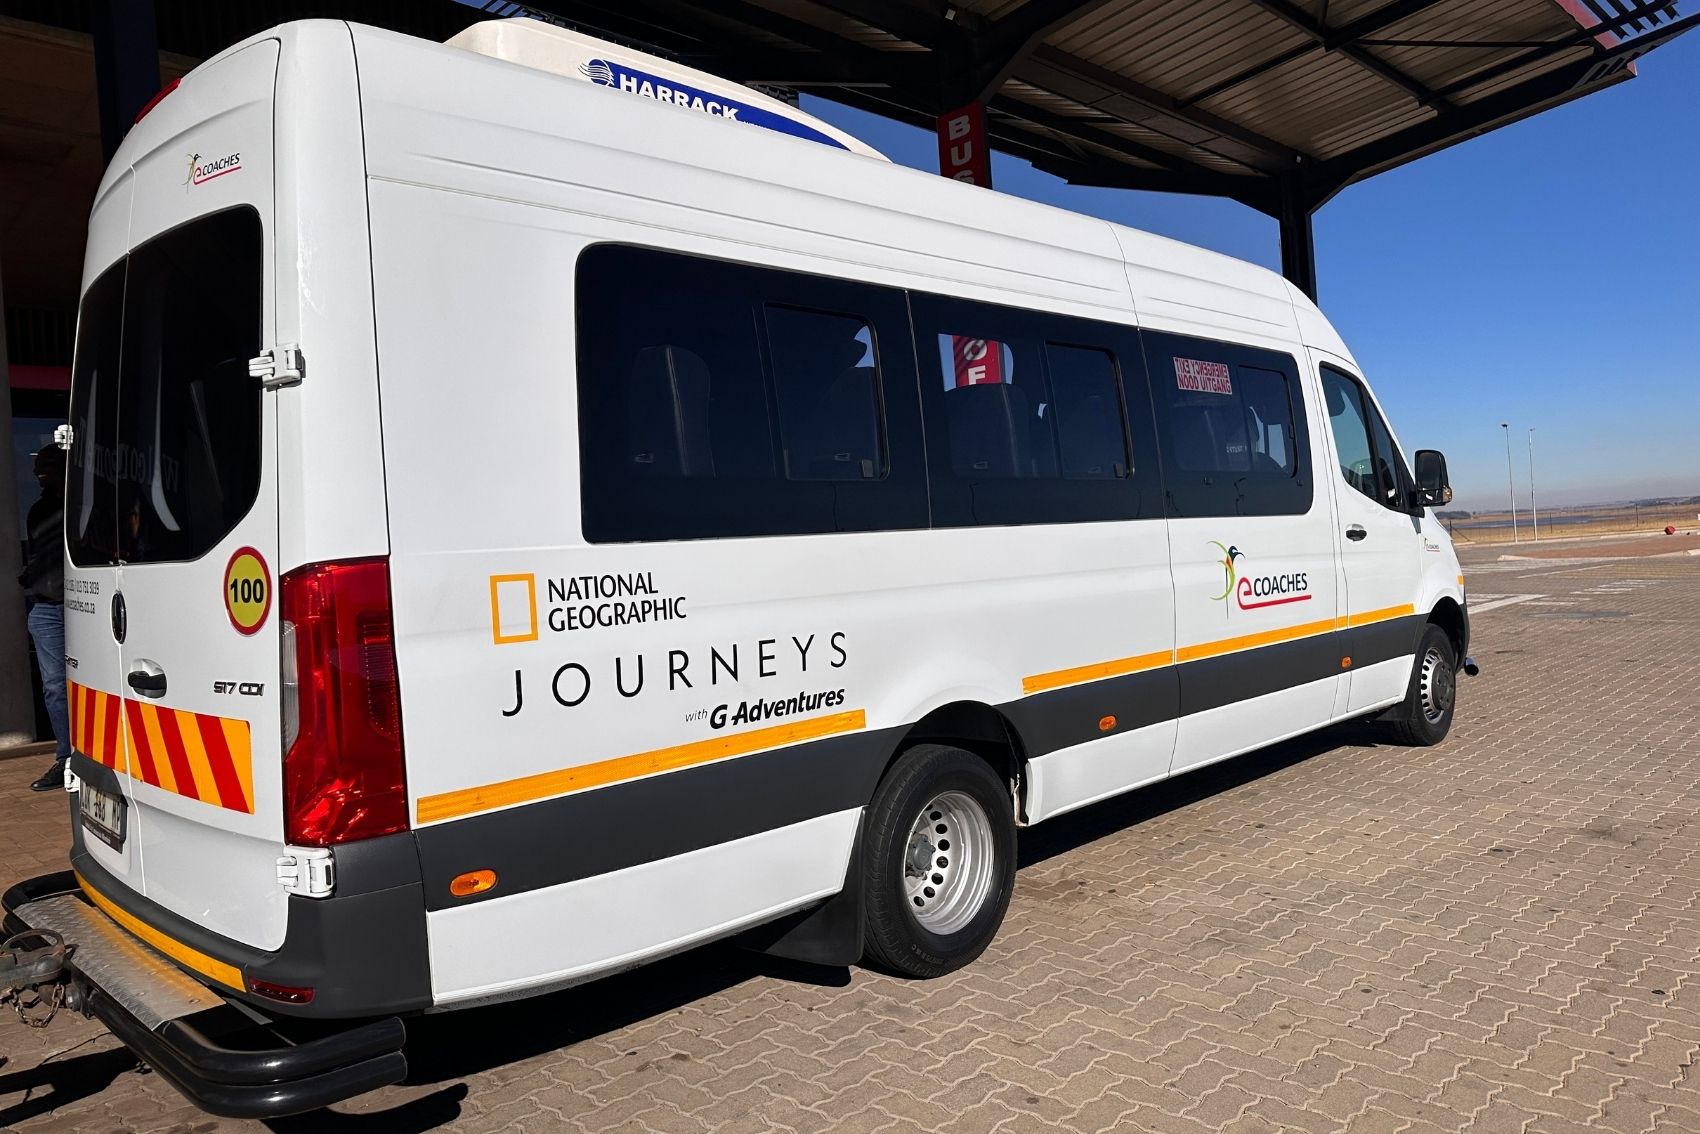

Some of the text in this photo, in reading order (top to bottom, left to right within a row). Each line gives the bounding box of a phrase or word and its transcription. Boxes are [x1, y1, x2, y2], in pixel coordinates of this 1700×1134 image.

[619, 73, 739, 121] HARRACK
[1178, 373, 1231, 393] NOOD UITGANG
[229, 578, 264, 604] 100
[547, 572, 659, 603] NATIONAL
[547, 597, 687, 632] GEOGRAPHIC
[502, 631, 847, 717] JOURNEYS
[685, 687, 846, 730] with G Adventures
